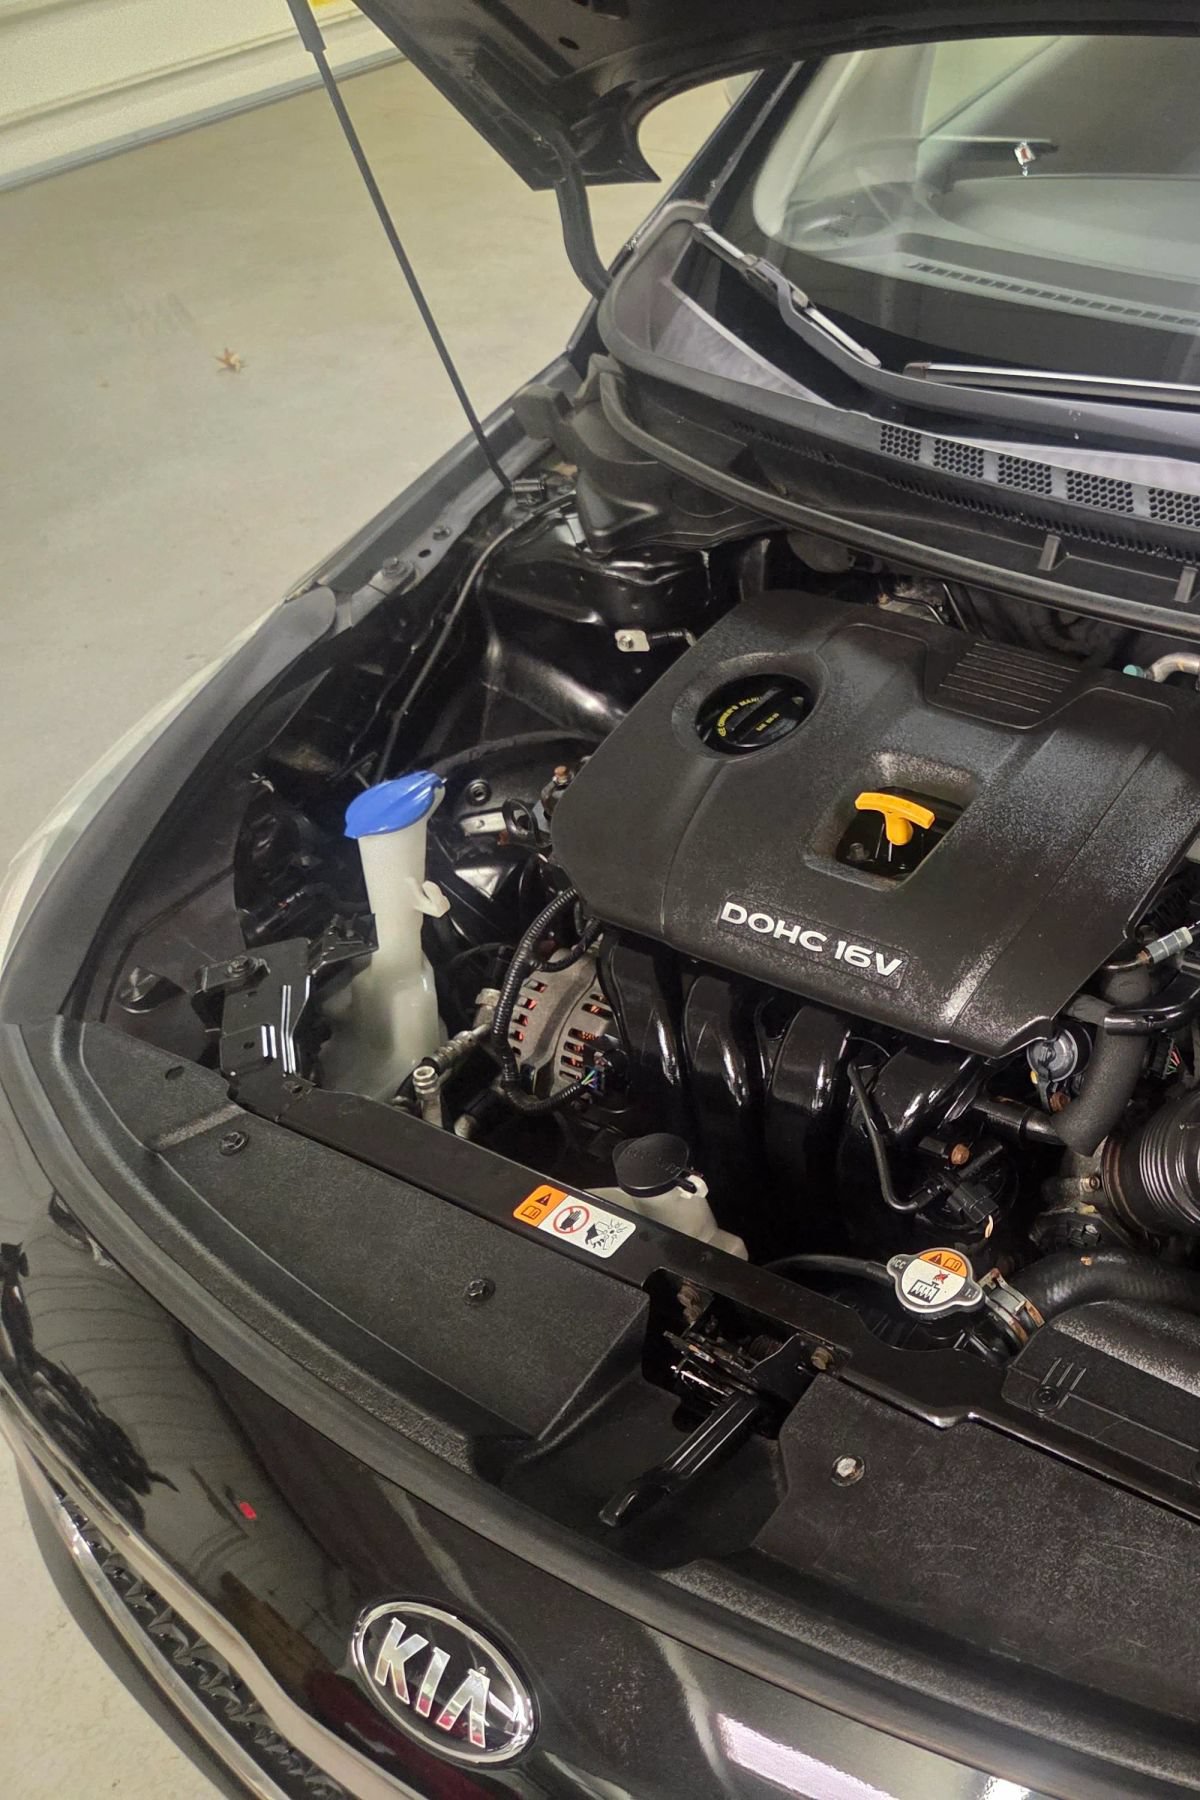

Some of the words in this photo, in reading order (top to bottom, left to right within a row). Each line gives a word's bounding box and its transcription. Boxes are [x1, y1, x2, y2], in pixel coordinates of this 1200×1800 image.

[720, 901, 828, 954] DOHC
[833, 939, 903, 977] 16V
[374, 1616, 491, 1749] KIA
